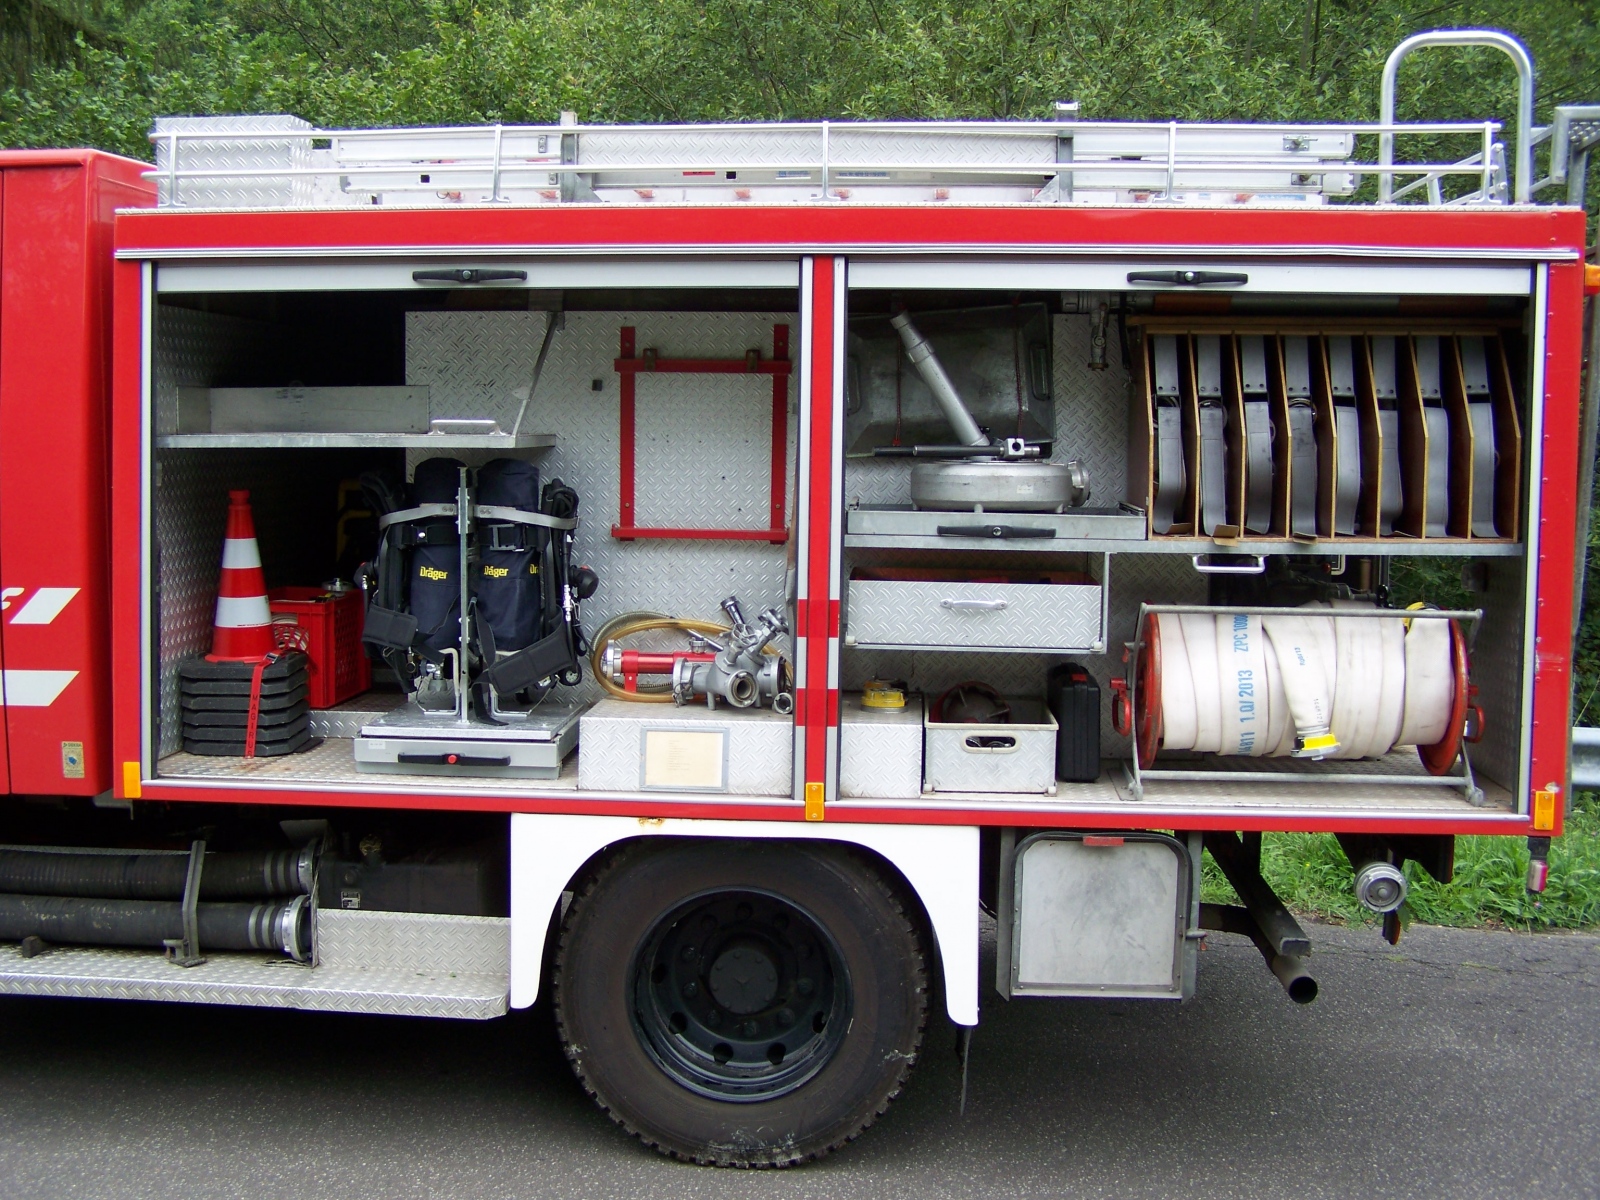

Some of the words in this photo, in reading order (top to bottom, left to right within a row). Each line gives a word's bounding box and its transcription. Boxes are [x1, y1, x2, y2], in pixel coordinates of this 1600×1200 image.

[420, 566, 448, 580] Dräger
[1233, 633, 1249, 653] ZPC
[1237, 670, 1253, 697] 2013
